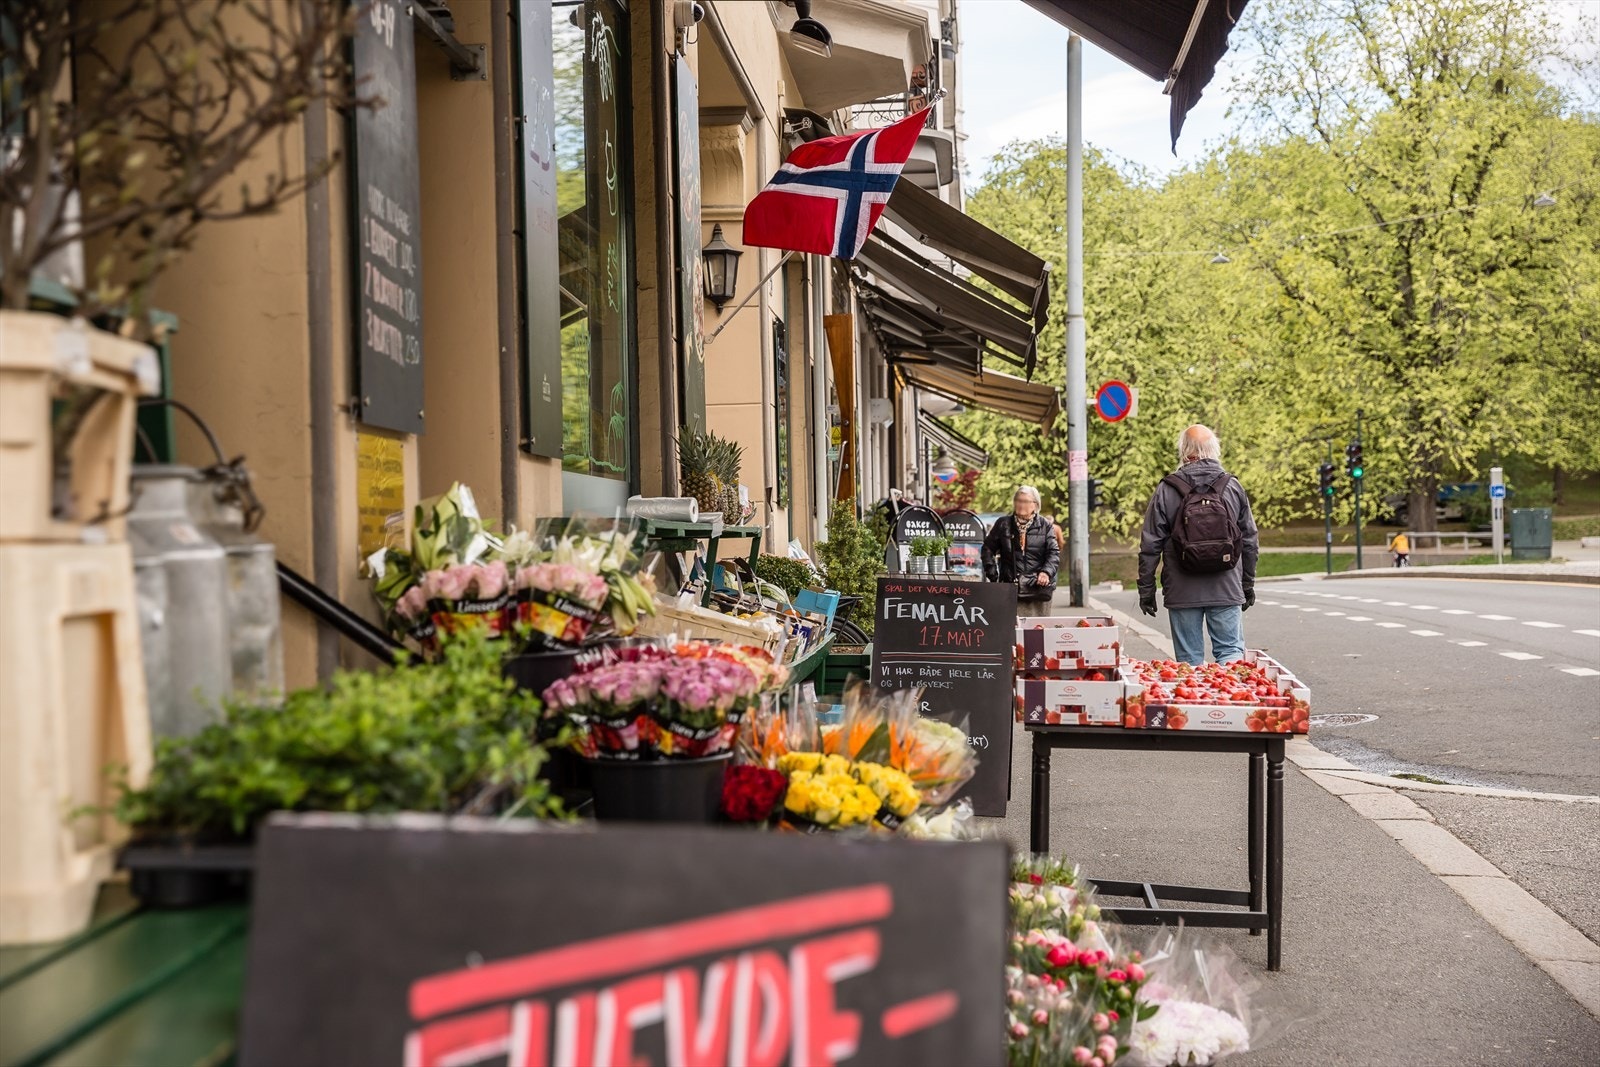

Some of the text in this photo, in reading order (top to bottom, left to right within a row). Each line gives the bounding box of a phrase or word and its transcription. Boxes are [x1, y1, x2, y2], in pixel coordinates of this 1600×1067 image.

[885, 584, 971, 595] SKAL DET VÆRE NOE
[883, 597, 990, 626] FENALÅR
[919, 625, 944, 646] 17.
[881, 665, 996, 679] VI HAR BÅDE HELE LÅR
[967, 735, 989, 749] EKT)
